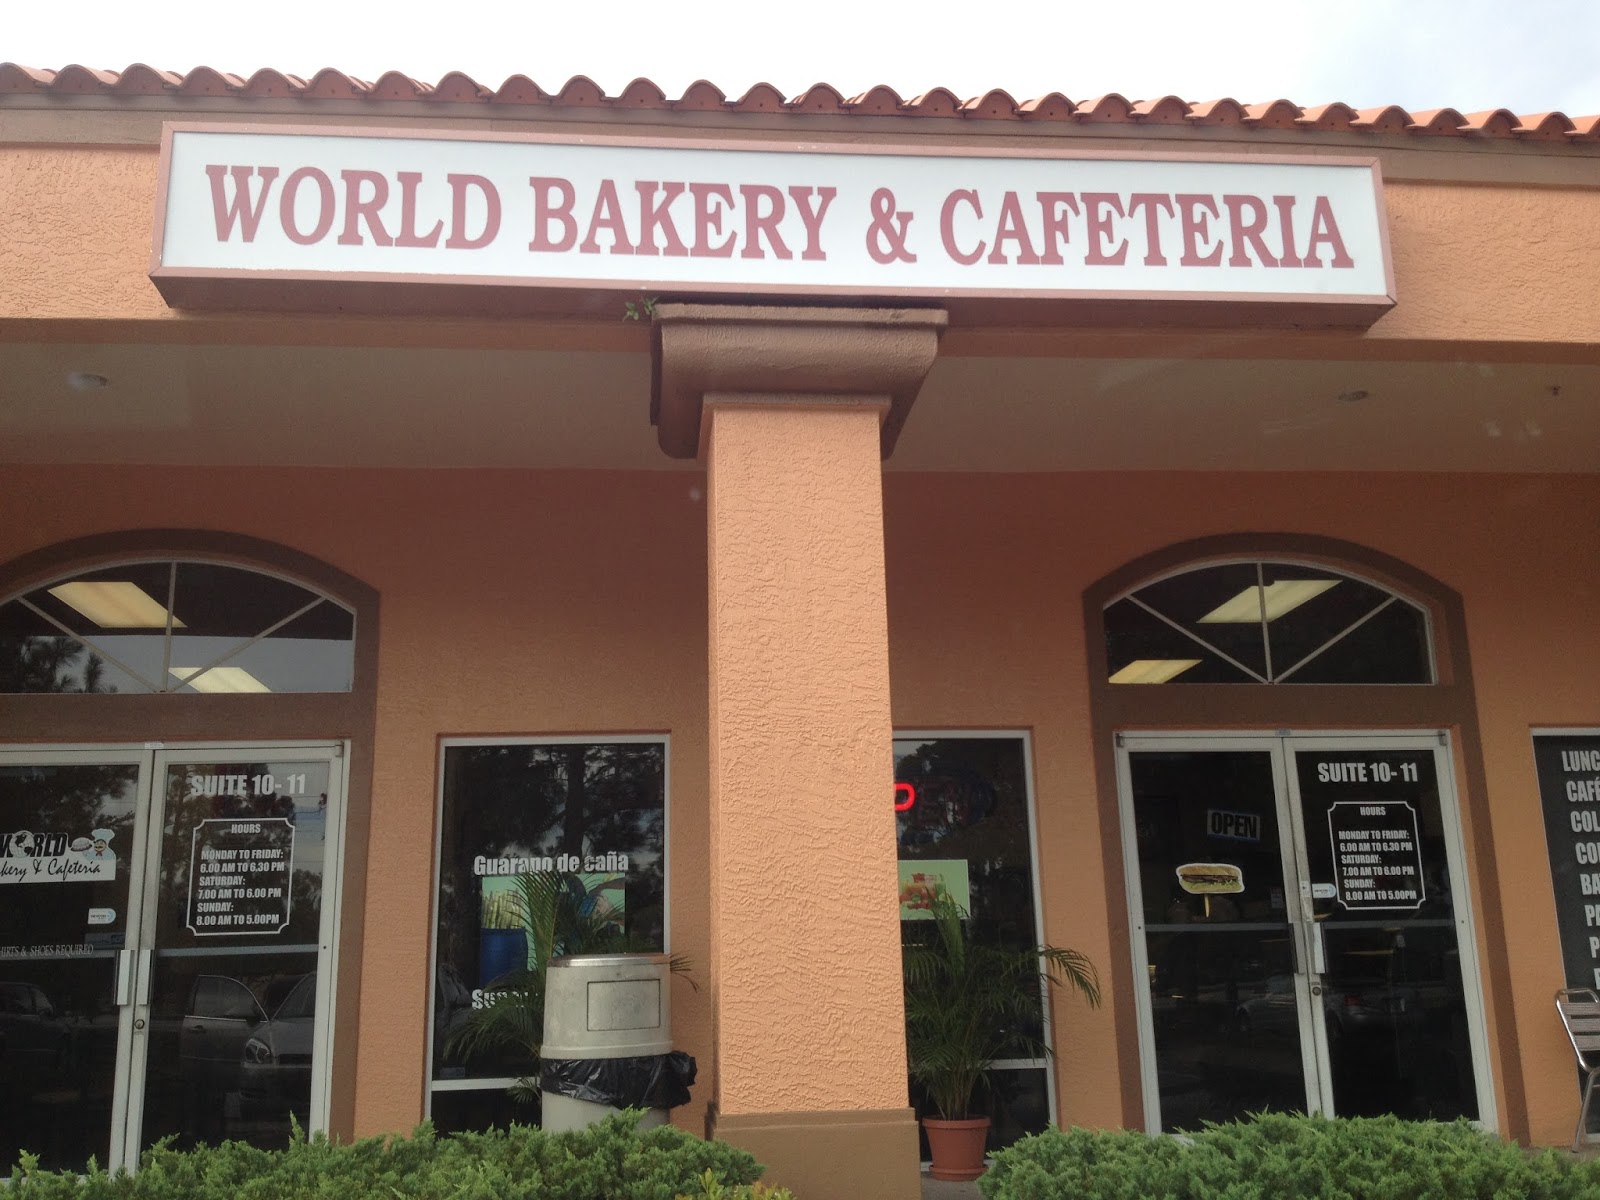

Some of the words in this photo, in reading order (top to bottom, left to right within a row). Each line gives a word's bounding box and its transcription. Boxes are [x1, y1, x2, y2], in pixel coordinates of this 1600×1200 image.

[205, 163, 502, 250] WORLD
[528, 175, 837, 261] BAKERY
[866, 187, 917, 265] &
[940, 188, 1355, 269] CAFETERIA
[1317, 762, 1368, 782] SUITE
[1400, 762, 1418, 782] 11
[191, 774, 247, 796] SUITE
[287, 774, 305, 794] 11
[1360, 806, 1386, 816] HOURS
[231, 824, 261, 834] HOURS
[1211, 812, 1257, 838] OPEN
[1338, 830, 1369, 840] MONDAY
[1370, 830, 1381, 840] TO
[1381, 830, 1410, 839] FRIDAY:
[1340, 842, 1357, 852] 6.00
[1358, 842, 1371, 852] AM
[1371, 842, 1381, 851] TO
[1382, 842, 1400, 852] 6.30
[1400, 842, 1413, 851] PM
[201, 850, 237, 860] MONDAY
[239, 850, 250, 860] TO
[251, 849, 284, 859] FRIDAY:
[1341, 854, 1382, 864] SATURDAY:
[200, 863, 220, 873] 6.00
[221, 863, 235, 873] AM
[237, 862, 249, 872] TO
[250, 862, 270, 872] 6.30
[271, 862, 285, 872] PM
[556, 853, 580, 873] de
[584, 851, 629, 872] caña
[48, 858, 101, 881] Cafeteria
[1342, 867, 1359, 876] 7.00
[1360, 867, 1372, 876] AM
[1372, 867, 1383, 876] TO
[1383, 866, 1401, 876] 6.00
[1402, 866, 1415, 875] PM
[199, 876, 245, 886] SATURDAY:
[1344, 879, 1376, 889] SUNDAY:
[1580, 873, 1600, 895] BA
[198, 889, 217, 899] 7.00
[218, 889, 232, 899] AM
[233, 889, 245, 899] TO
[246, 888, 266, 898] 6.00
[267, 888, 282, 898] PM
[1345, 891, 1363, 901] 8.00
[1364, 891, 1376, 900] AM
[1376, 891, 1387, 900] TO
[197, 902, 234, 912] SUNDAY:
[196, 915, 216, 926] 8.00
[217, 915, 231, 925] AM
[233, 915, 245, 924] TO
[20, 946, 27, 958] &
[30, 945, 54, 957] SHOES
[55, 944, 94, 958] REQUIRED
